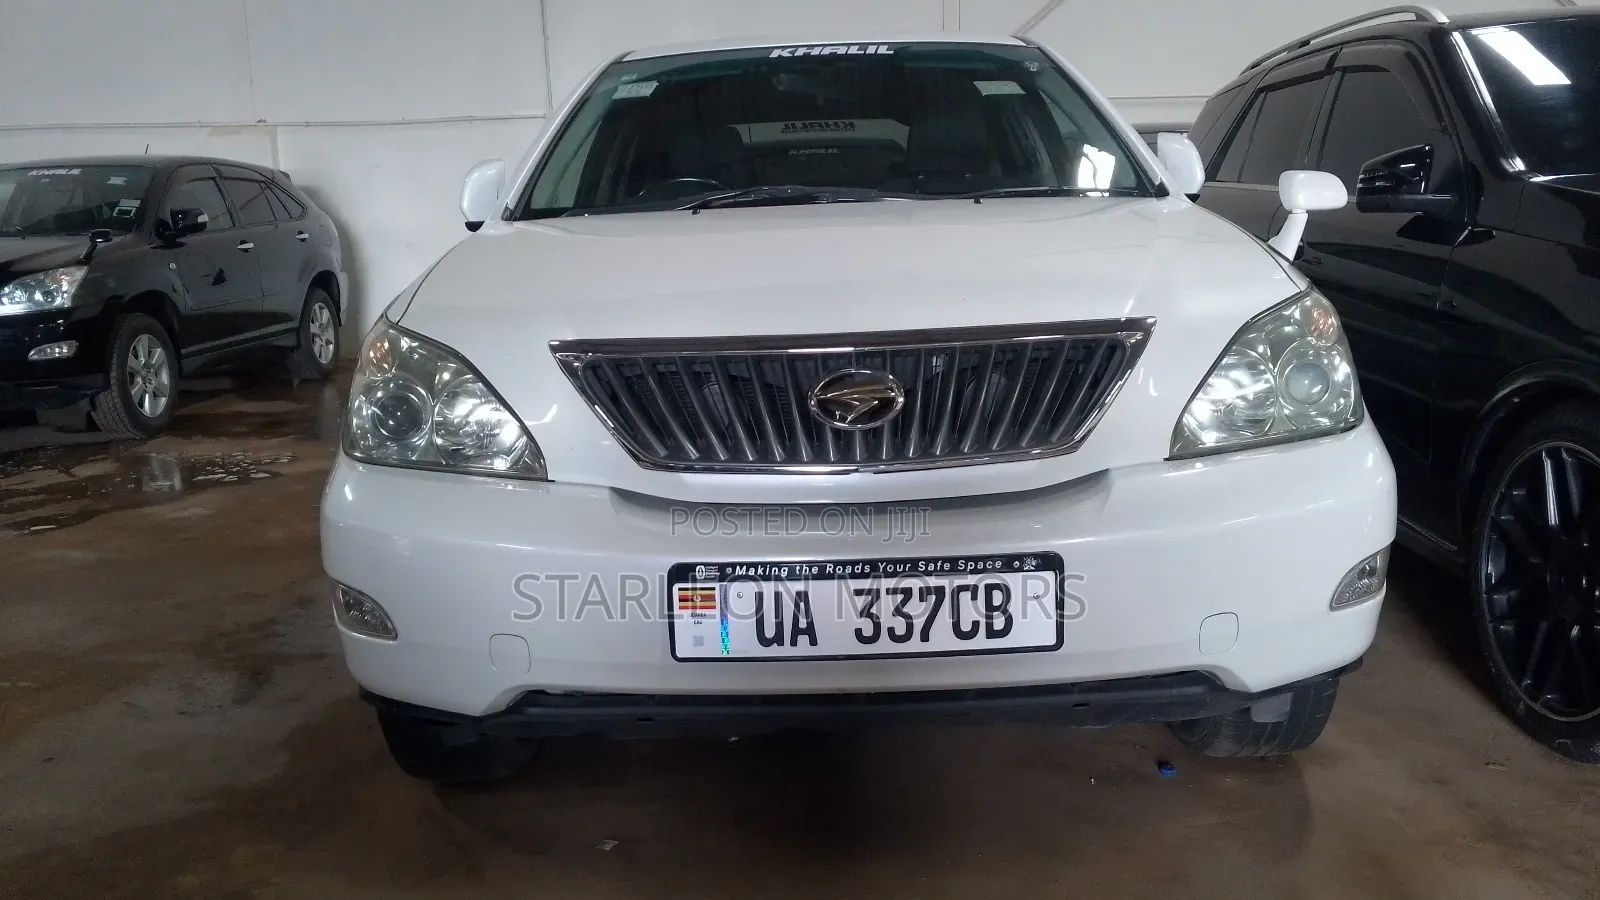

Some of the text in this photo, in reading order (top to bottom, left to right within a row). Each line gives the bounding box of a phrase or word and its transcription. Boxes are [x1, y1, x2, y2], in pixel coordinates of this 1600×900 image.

[769, 45, 894, 58] KHALIL
[735, 559, 1002, 577] Making the Roads Your Safe Space
[755, 583, 1014, 647] UA 337CB
